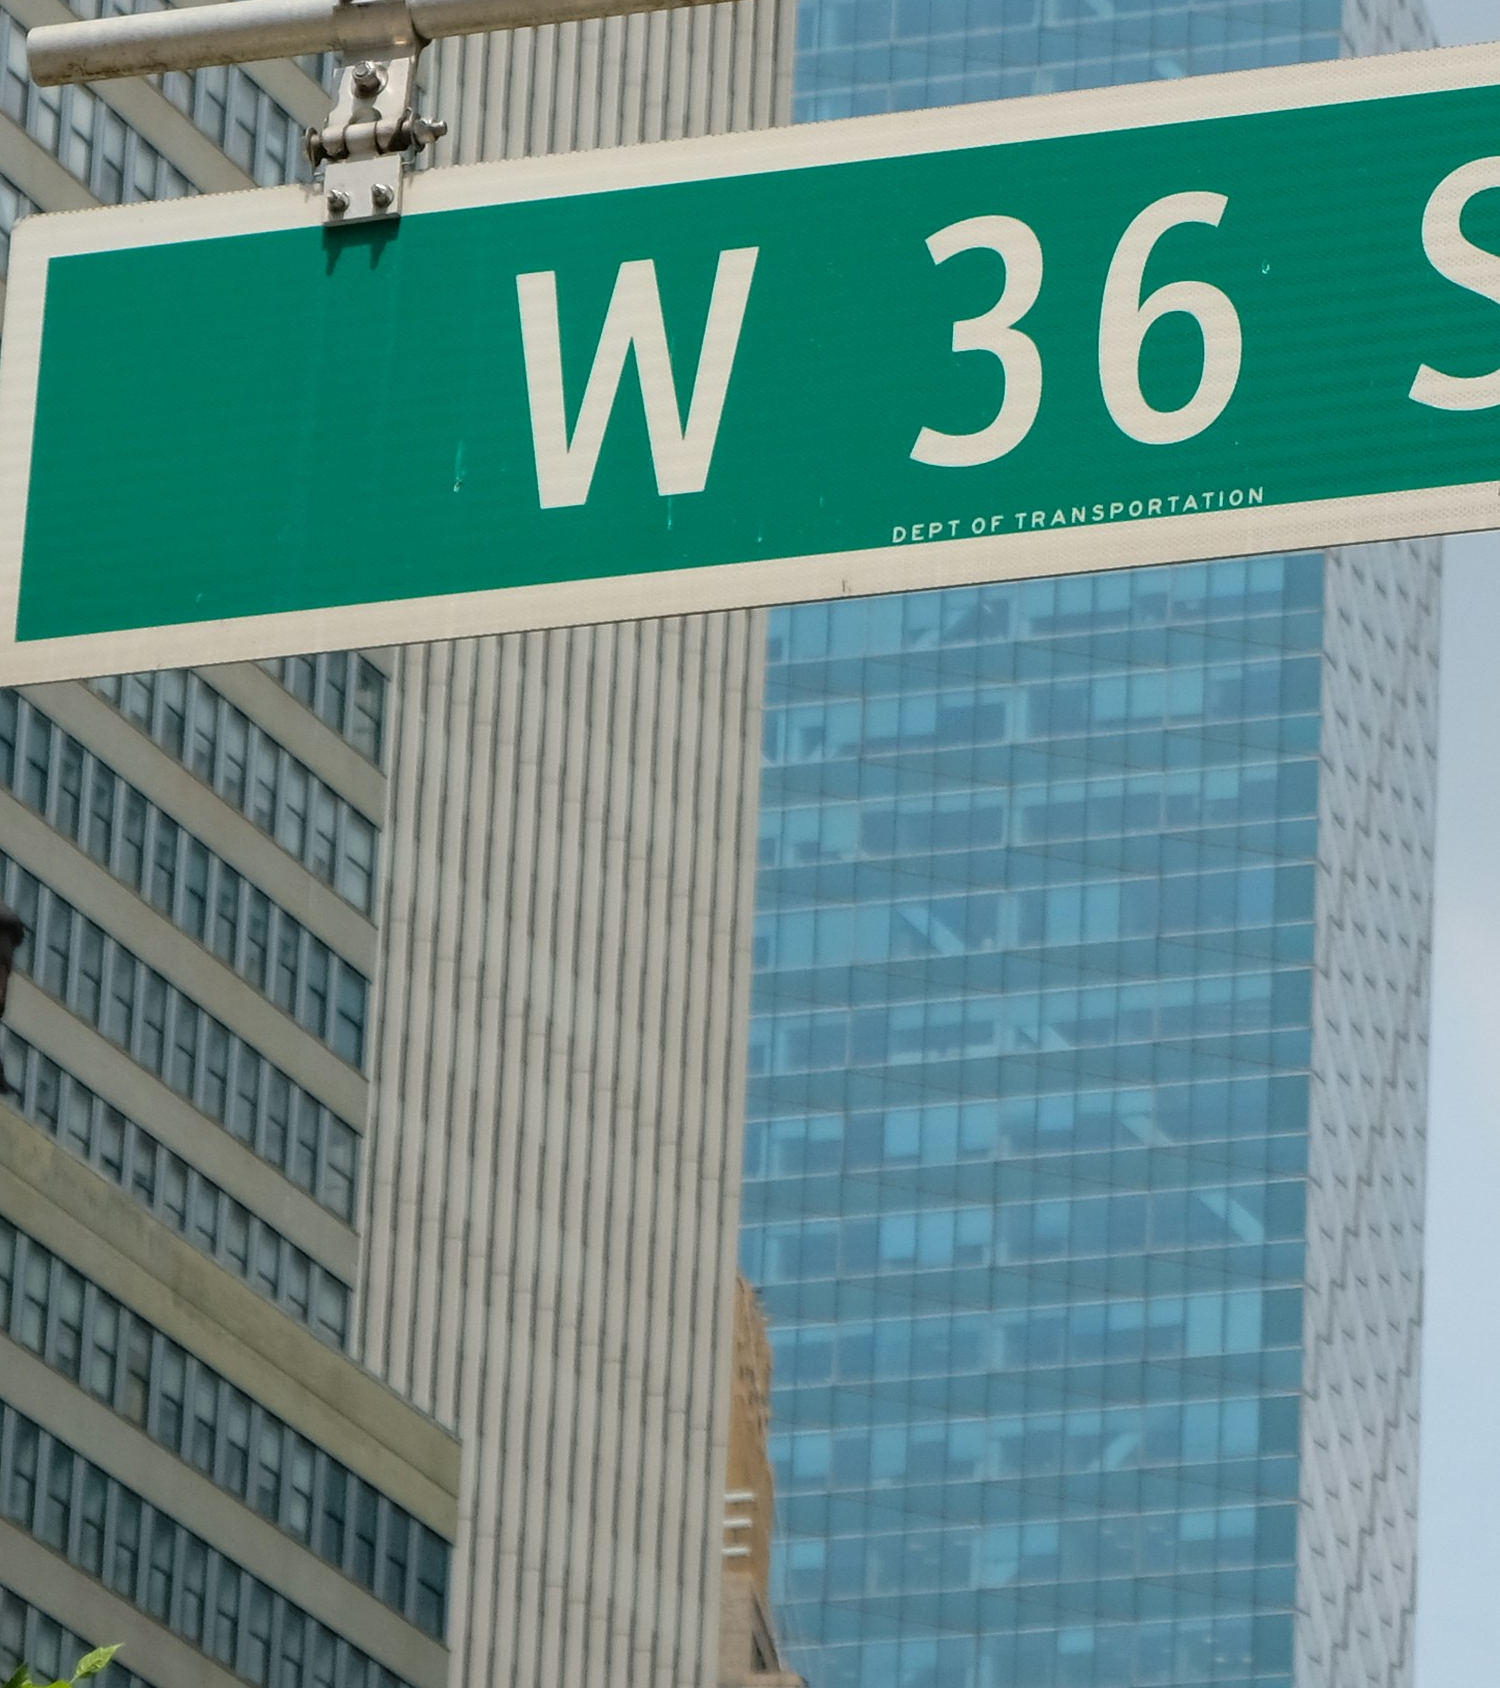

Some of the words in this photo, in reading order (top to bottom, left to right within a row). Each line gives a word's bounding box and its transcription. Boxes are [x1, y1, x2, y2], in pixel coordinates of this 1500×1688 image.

[516, 246, 760, 509] W
[910, 191, 1243, 467] 36
[891, 519, 961, 543] DEPT
[971, 515, 1003, 534] OF
[1014, 487, 1264, 529] TRANSPORTATION
